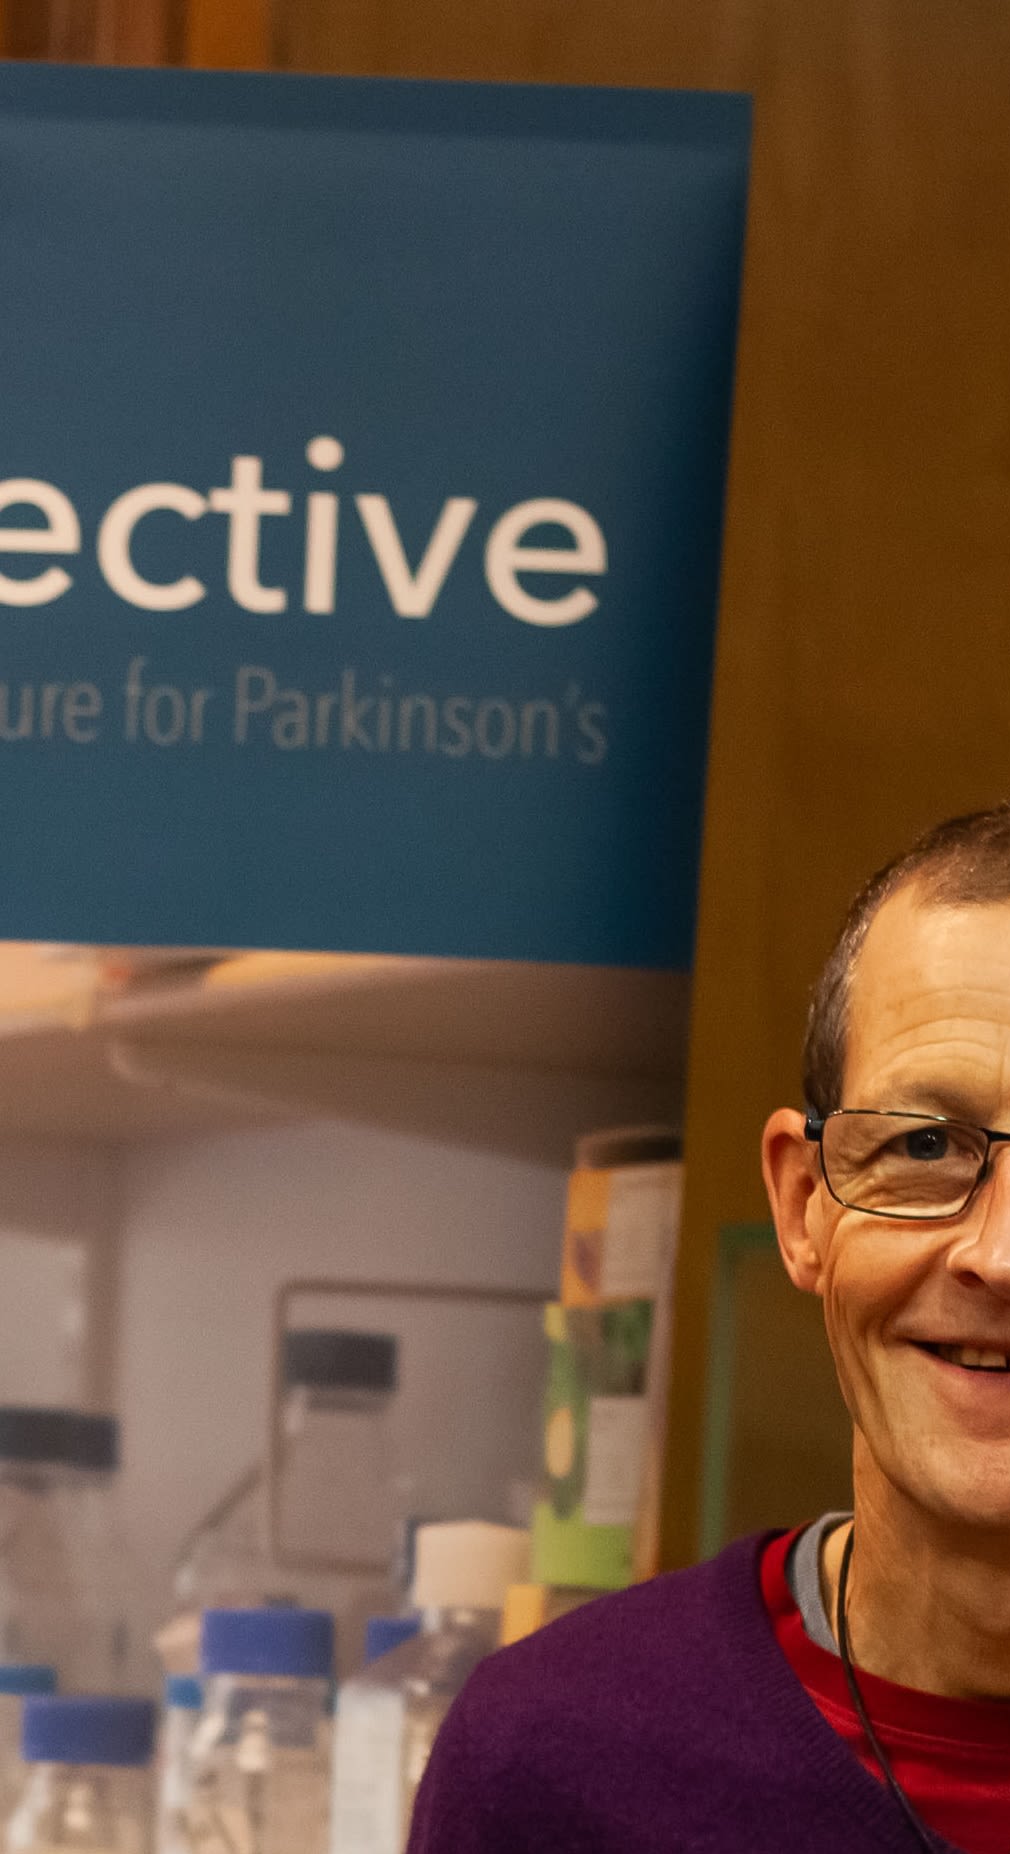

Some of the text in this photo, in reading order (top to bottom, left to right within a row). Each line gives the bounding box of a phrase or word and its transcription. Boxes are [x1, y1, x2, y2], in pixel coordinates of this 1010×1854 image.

[0, 435, 609, 627] ective
[123, 655, 212, 745] for
[234, 664, 609, 765] Parkinson's
